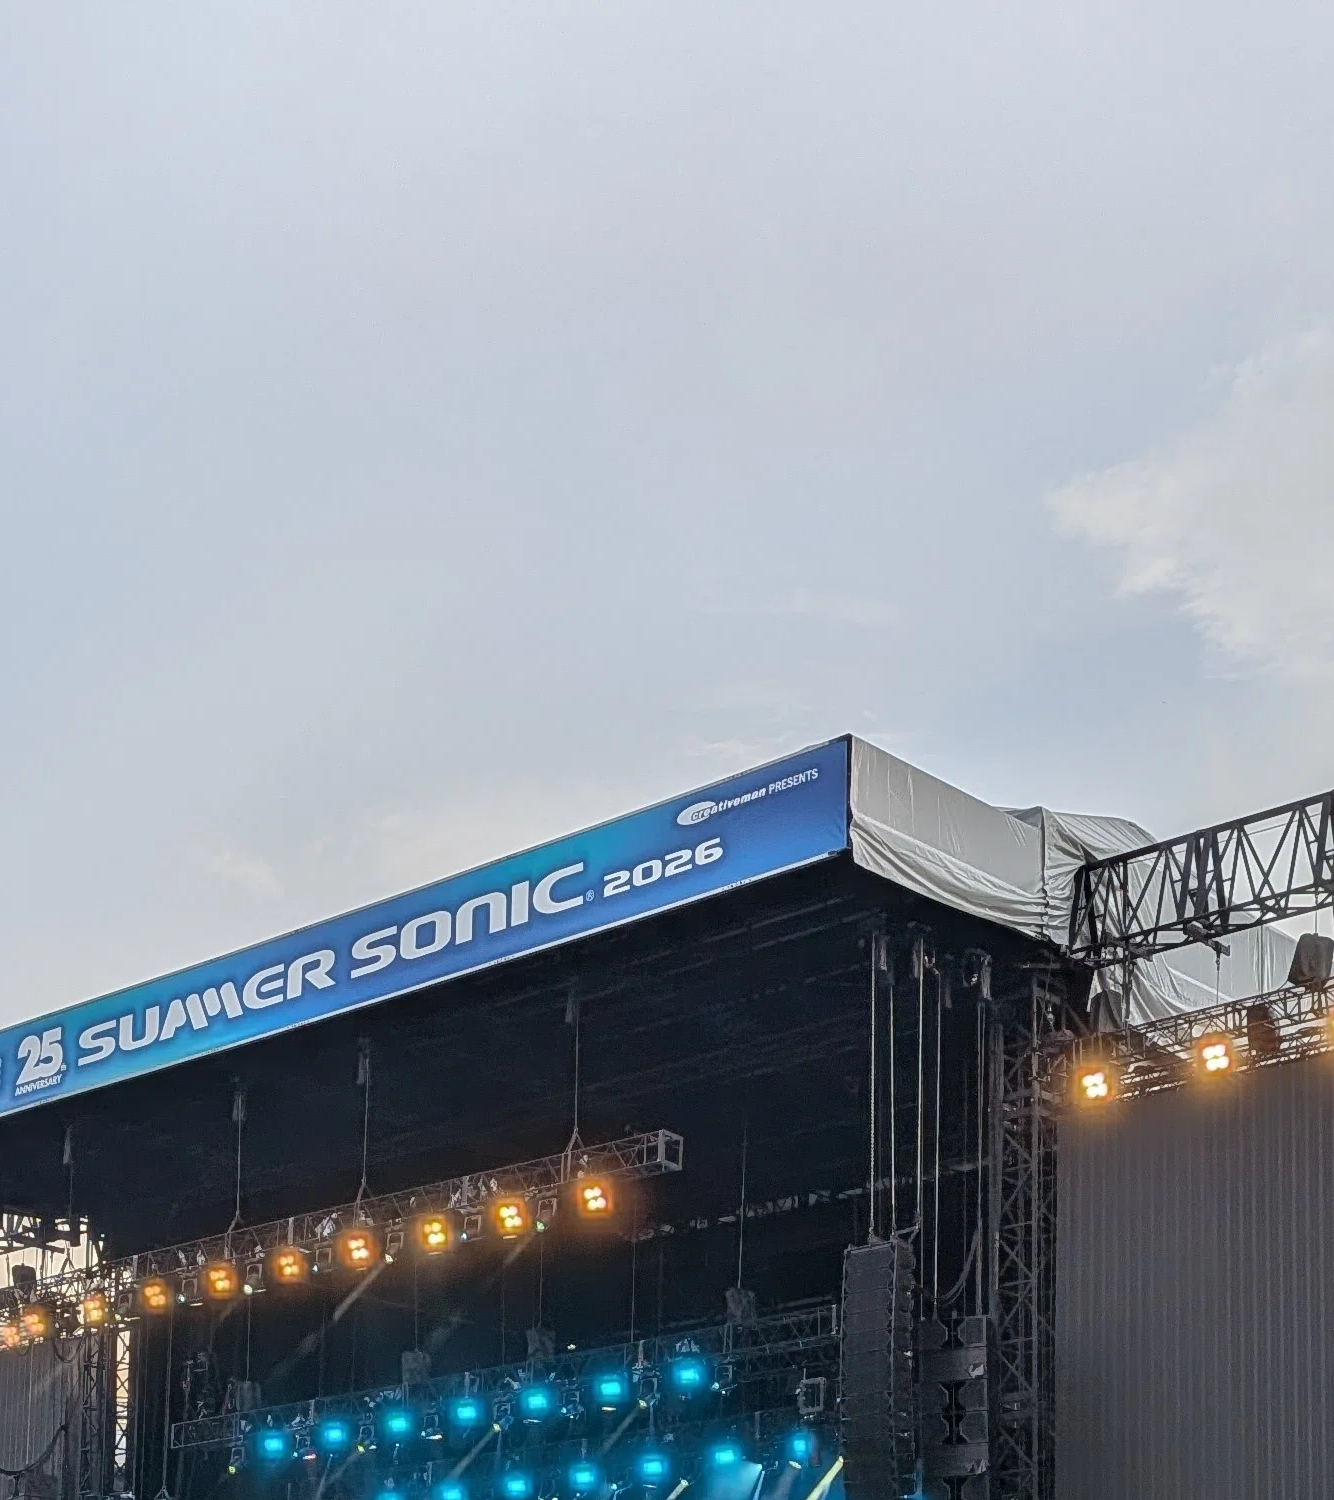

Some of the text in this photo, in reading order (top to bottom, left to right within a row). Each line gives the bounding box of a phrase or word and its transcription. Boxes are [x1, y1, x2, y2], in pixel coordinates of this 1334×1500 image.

[691, 768, 819, 822] creativeman PRESENTS
[77, 837, 724, 1067] SUMMER SONIC 2026
[15, 1074, 63, 1097] ANNIVERSARY
